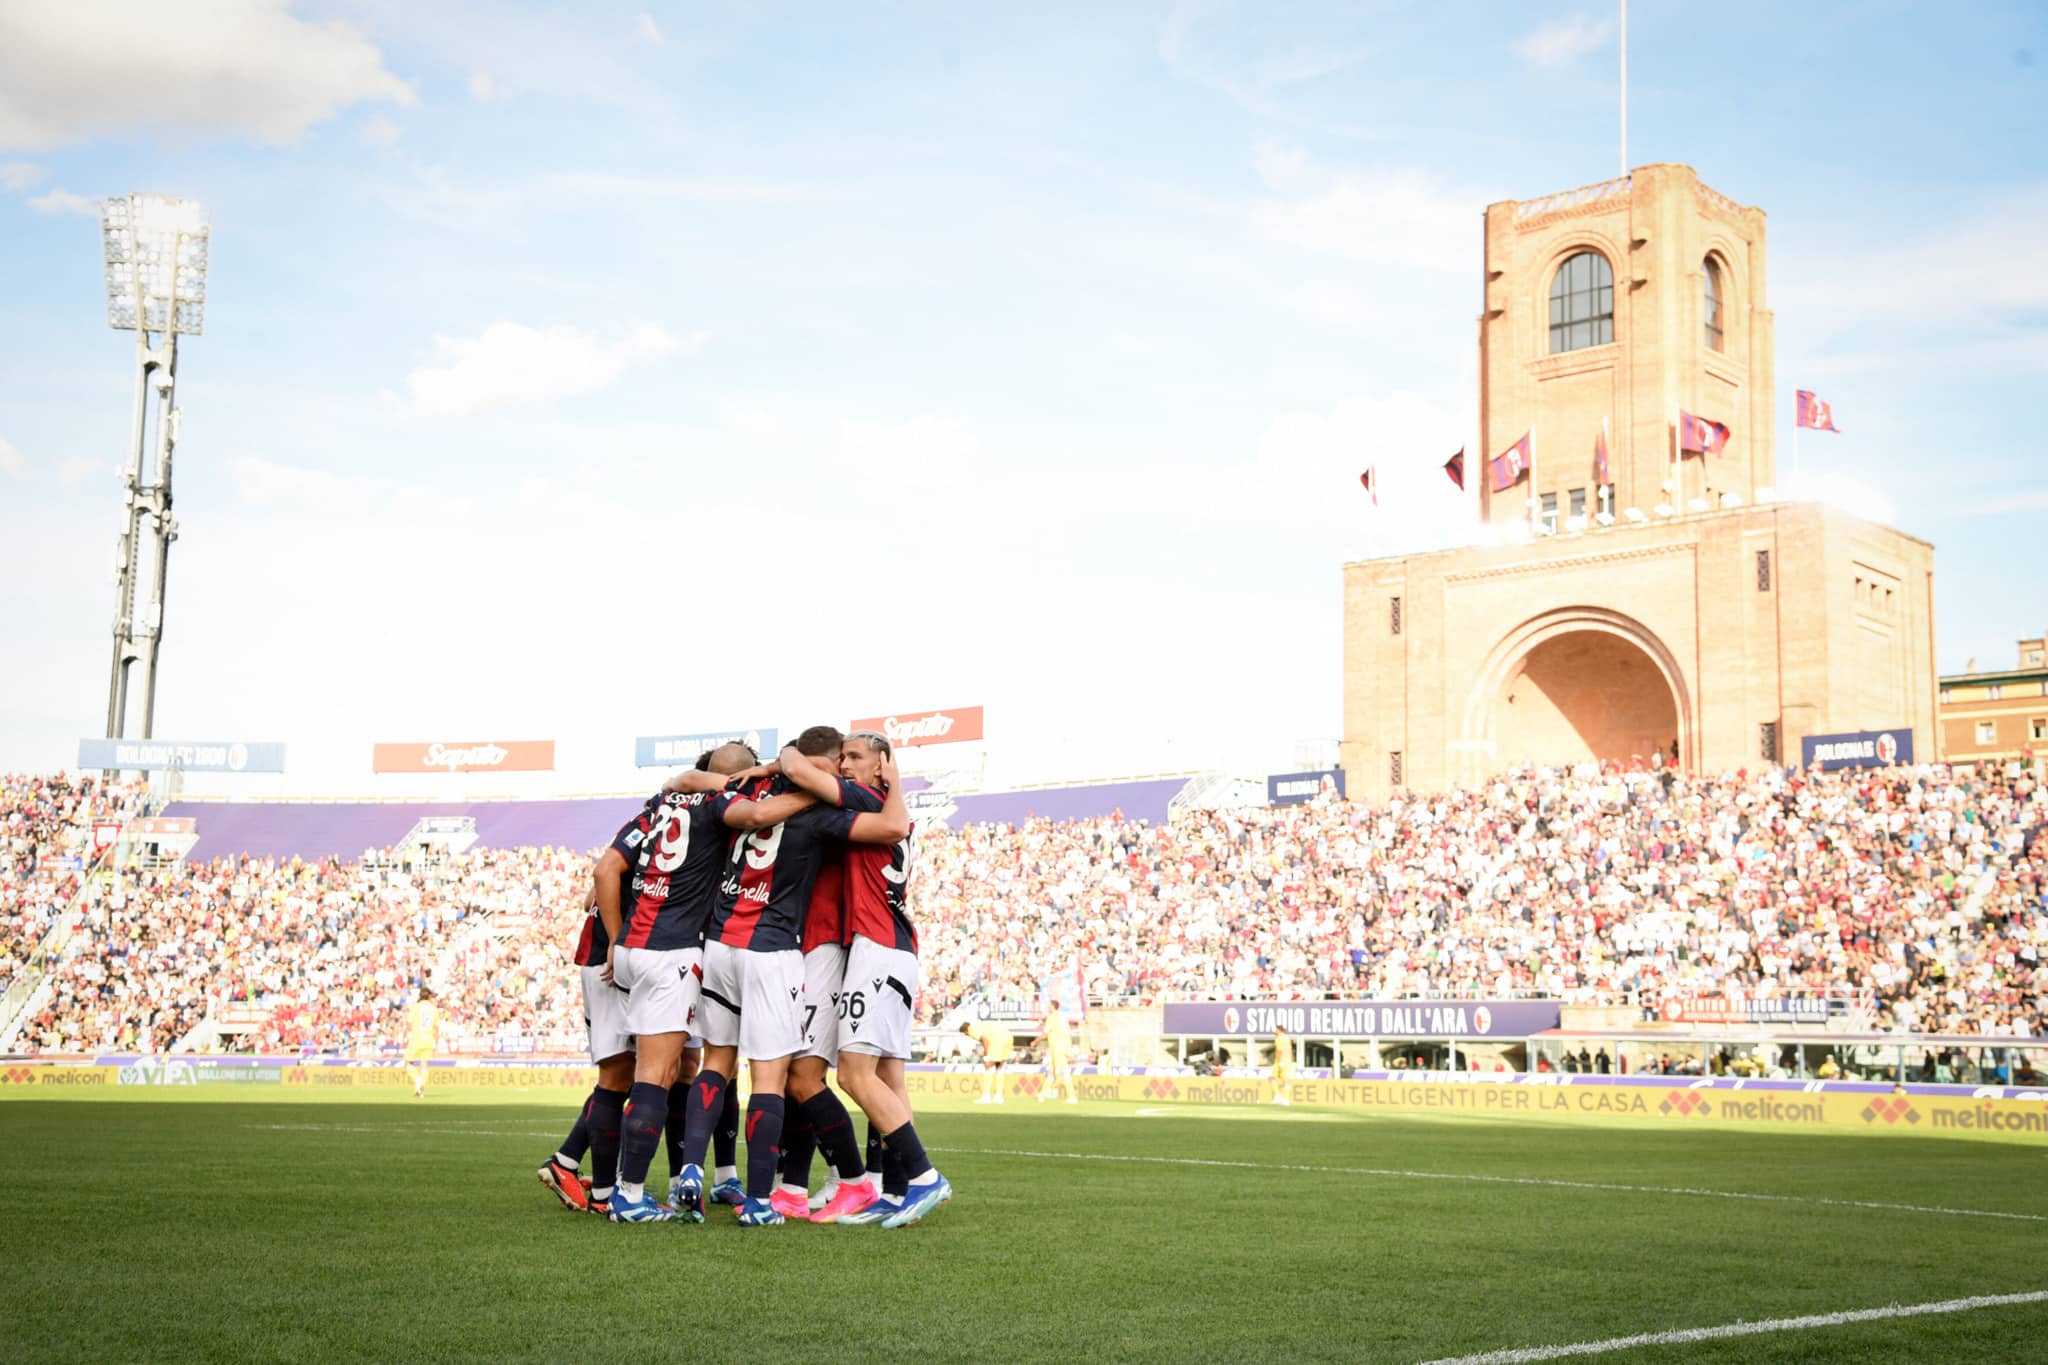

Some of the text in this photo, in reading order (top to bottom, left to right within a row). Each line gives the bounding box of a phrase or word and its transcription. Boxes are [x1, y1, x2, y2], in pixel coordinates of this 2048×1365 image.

[638, 804, 691, 872] 29
[1247, 1007, 1468, 1034] STADIO RENATO DALL'ARA
[42, 1069, 108, 1085] meliconi
[358, 1071, 385, 1084] IDEE
[472, 1072, 495, 1085] PER
[499, 1072, 516, 1085] LA
[520, 1072, 554, 1086] CASA
[931, 1078, 951, 1093] LA
[1187, 1082, 1259, 1101] meliconi
[1326, 1085, 1475, 1107] INTELLIGENTI
[1485, 1089, 1528, 1109] PER
[1539, 1091, 1569, 1110] LA
[1578, 1092, 1647, 1113] CASA
[1721, 1095, 1825, 1121] meliconi
[1932, 1102, 2048, 1131] meliconi
